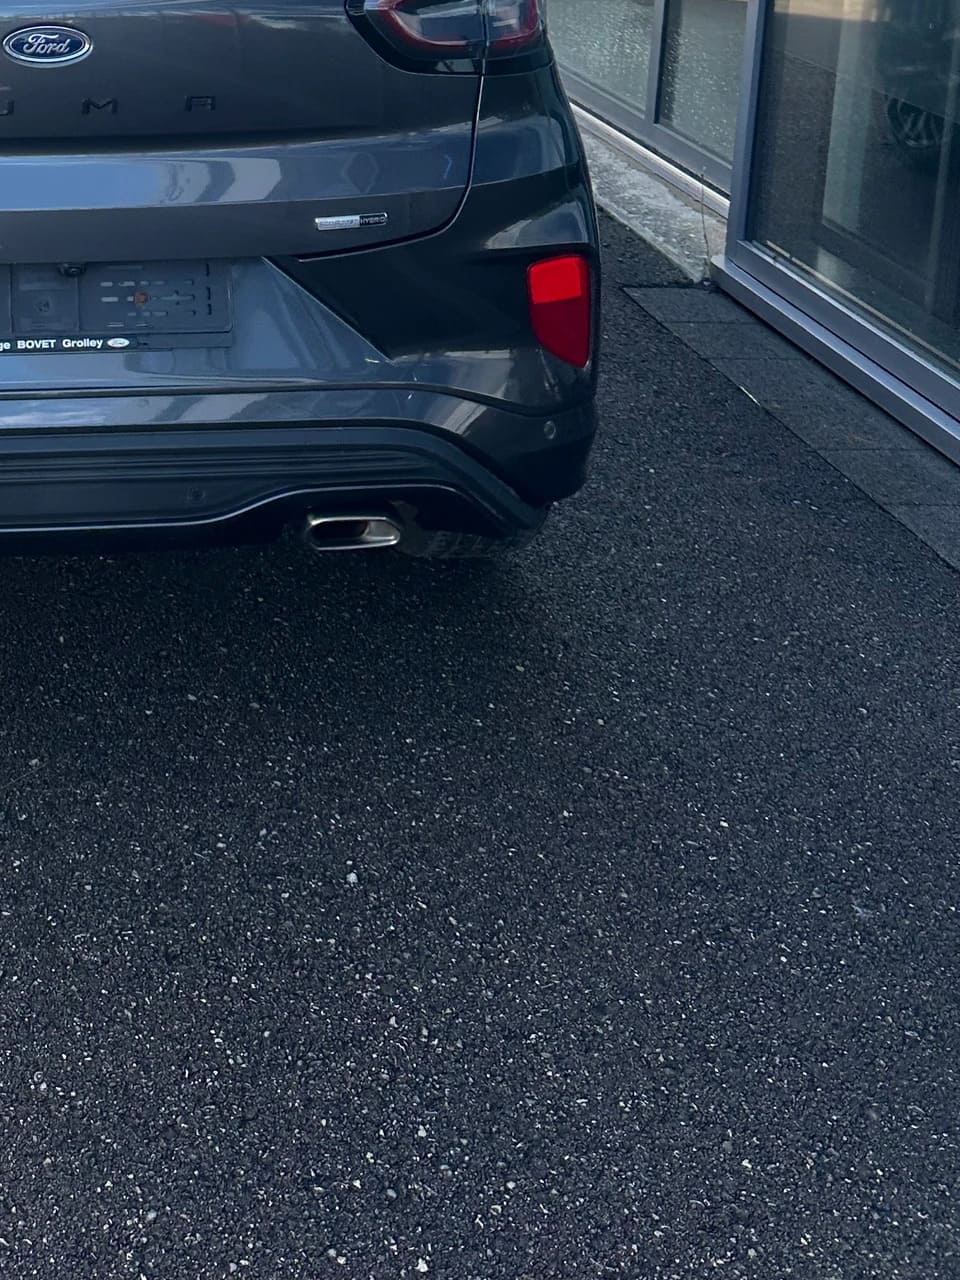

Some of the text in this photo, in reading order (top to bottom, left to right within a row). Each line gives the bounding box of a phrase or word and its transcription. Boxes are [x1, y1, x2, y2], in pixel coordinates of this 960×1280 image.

[23, 33, 71, 54] Ford
[17, 339, 57, 349] BOVET
[62, 338, 103, 348] Grolley
